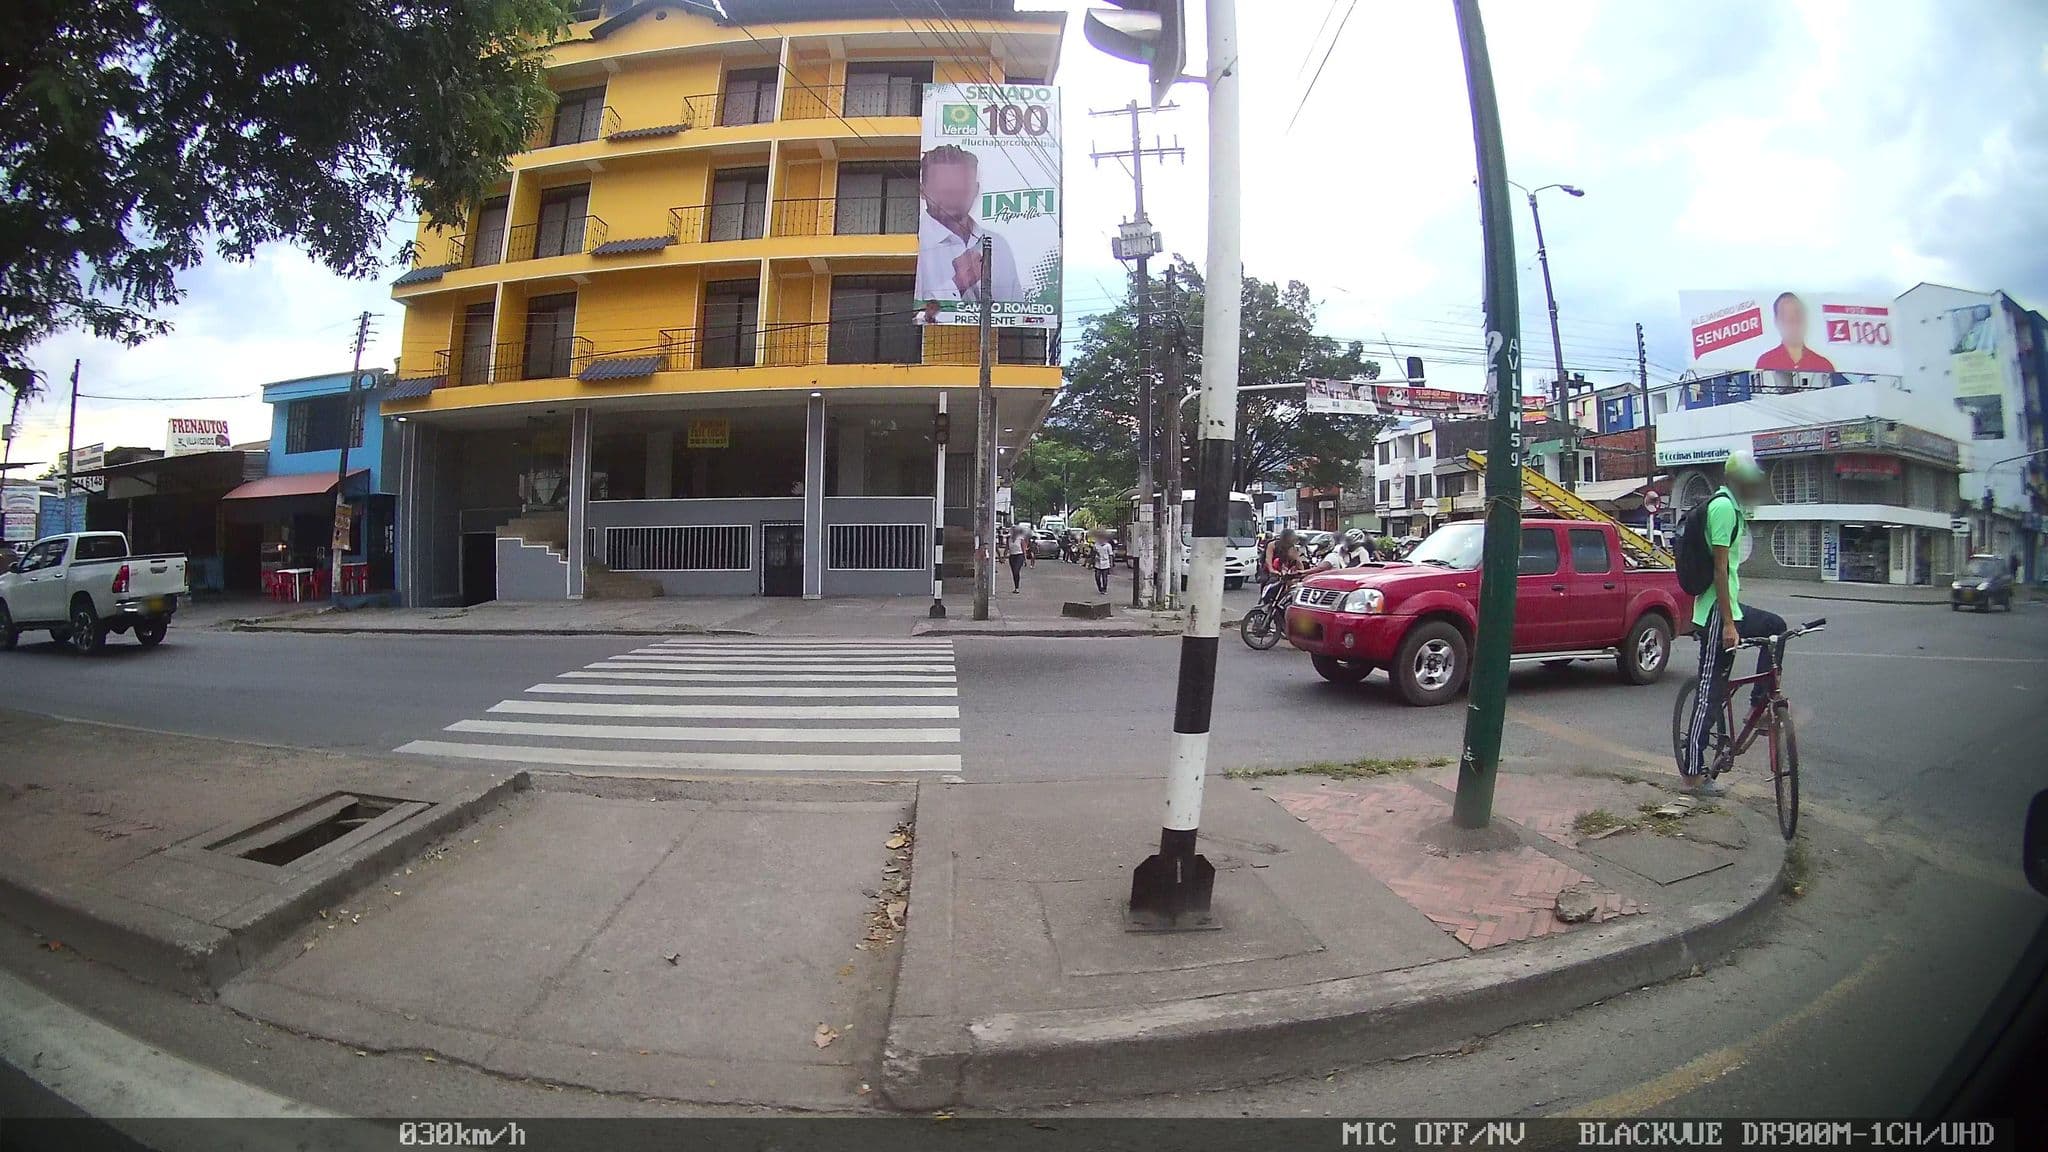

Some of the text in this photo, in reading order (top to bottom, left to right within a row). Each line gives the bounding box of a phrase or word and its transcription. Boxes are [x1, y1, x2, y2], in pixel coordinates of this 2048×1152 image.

[965, 85, 1051, 101] SENADO
[983, 105, 1048, 136] 100
[943, 125, 977, 135] Verde
[982, 190, 1054, 218] INTI
[1005, 303, 1054, 315] ROMERO
[955, 315, 1016, 326] PRESENTE
[1695, 317, 1759, 348] SENADOR
[172, 419, 229, 434] FRENAUTOS
